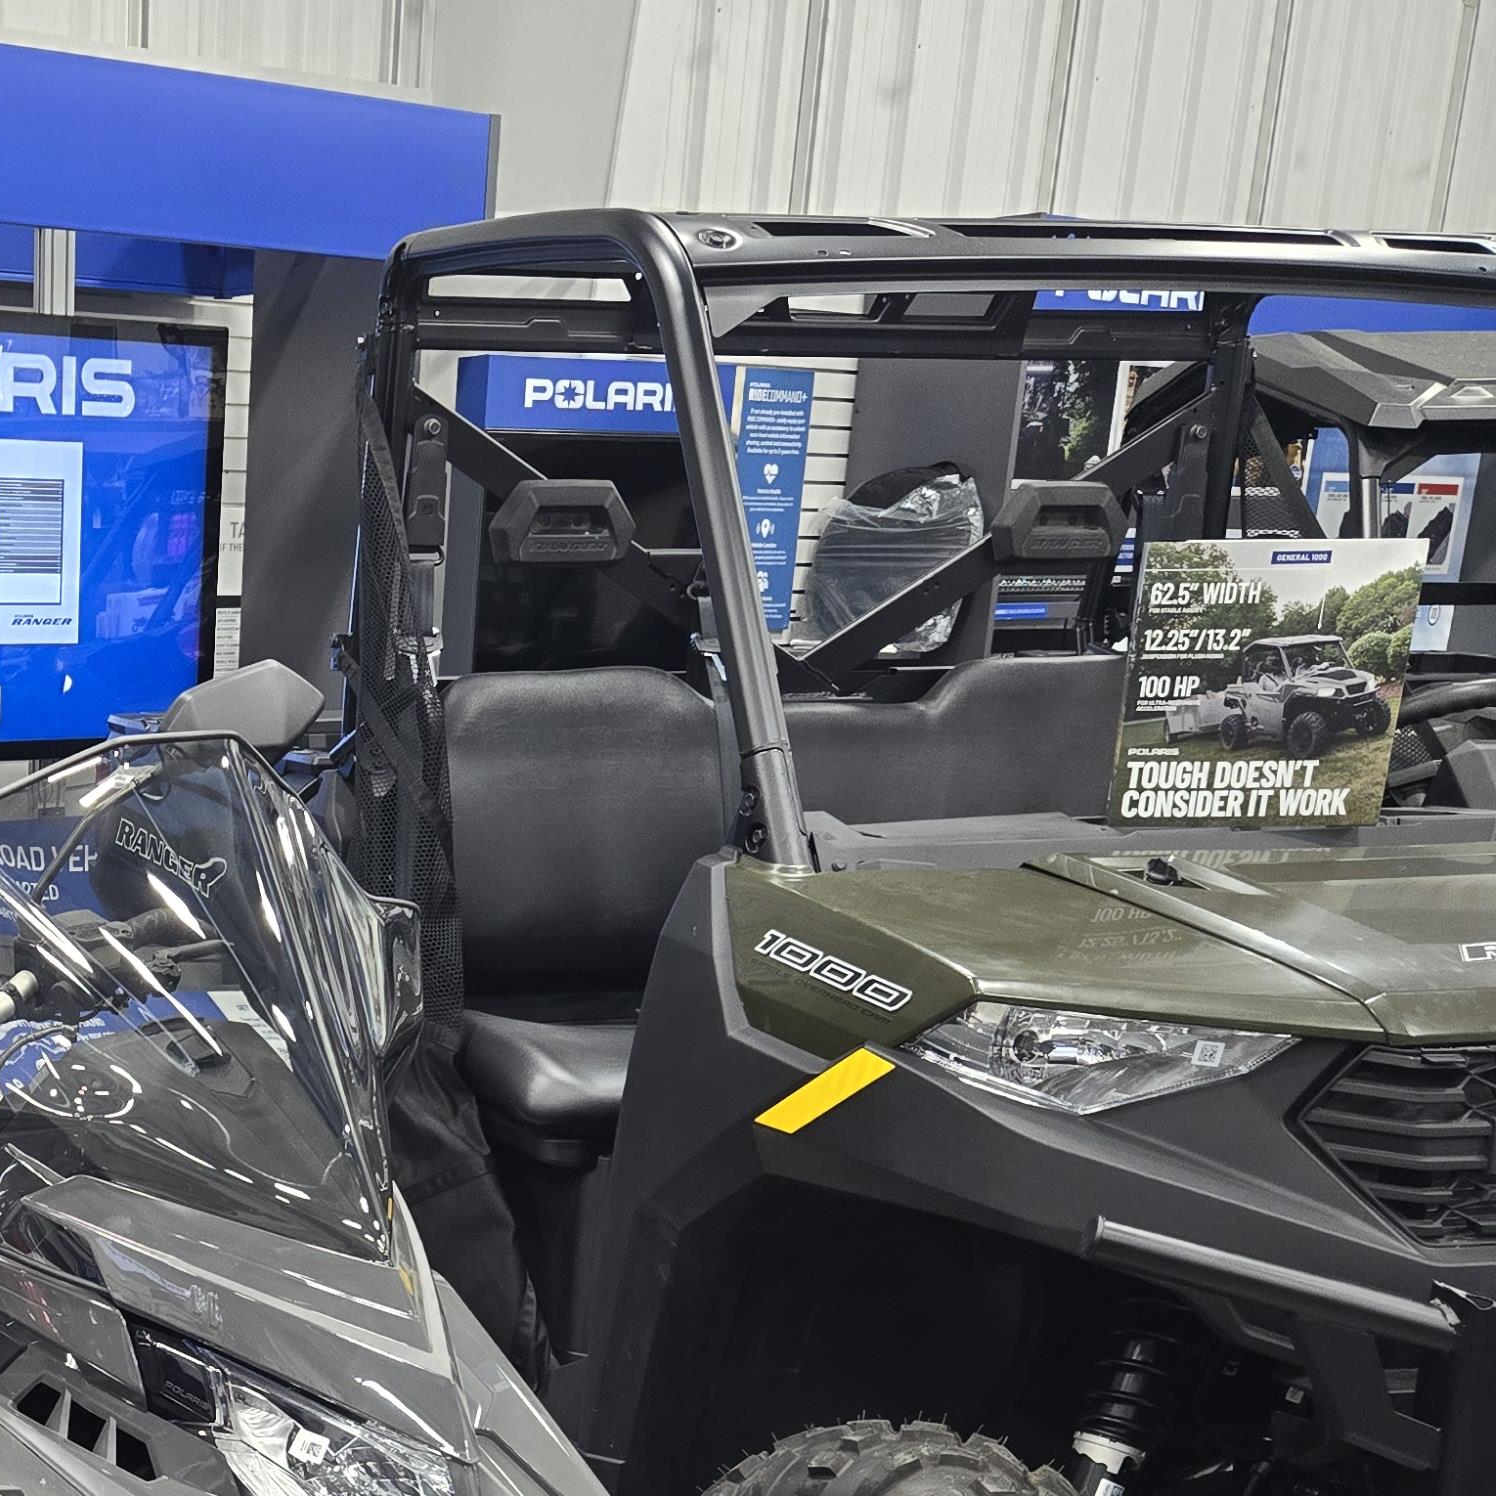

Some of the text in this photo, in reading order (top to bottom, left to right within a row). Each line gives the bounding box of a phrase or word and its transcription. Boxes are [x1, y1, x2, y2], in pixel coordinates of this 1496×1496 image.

[524, 378, 676, 412] POLARI
[1276, 552, 1329, 562] GENERAL 1000
[1203, 582, 1262, 605] WIDTH
[11, 617, 72, 625] RANGER
[1138, 675, 1200, 698] 100 HP
[1127, 748, 1180, 756] POLARIS
[1126, 759, 1320, 789] TOUGH DOESN'T
[1120, 787, 1351, 818] CONSIDER IT WORK
[115, 817, 228, 898] RANGER
[754, 929, 913, 1012] 1000
